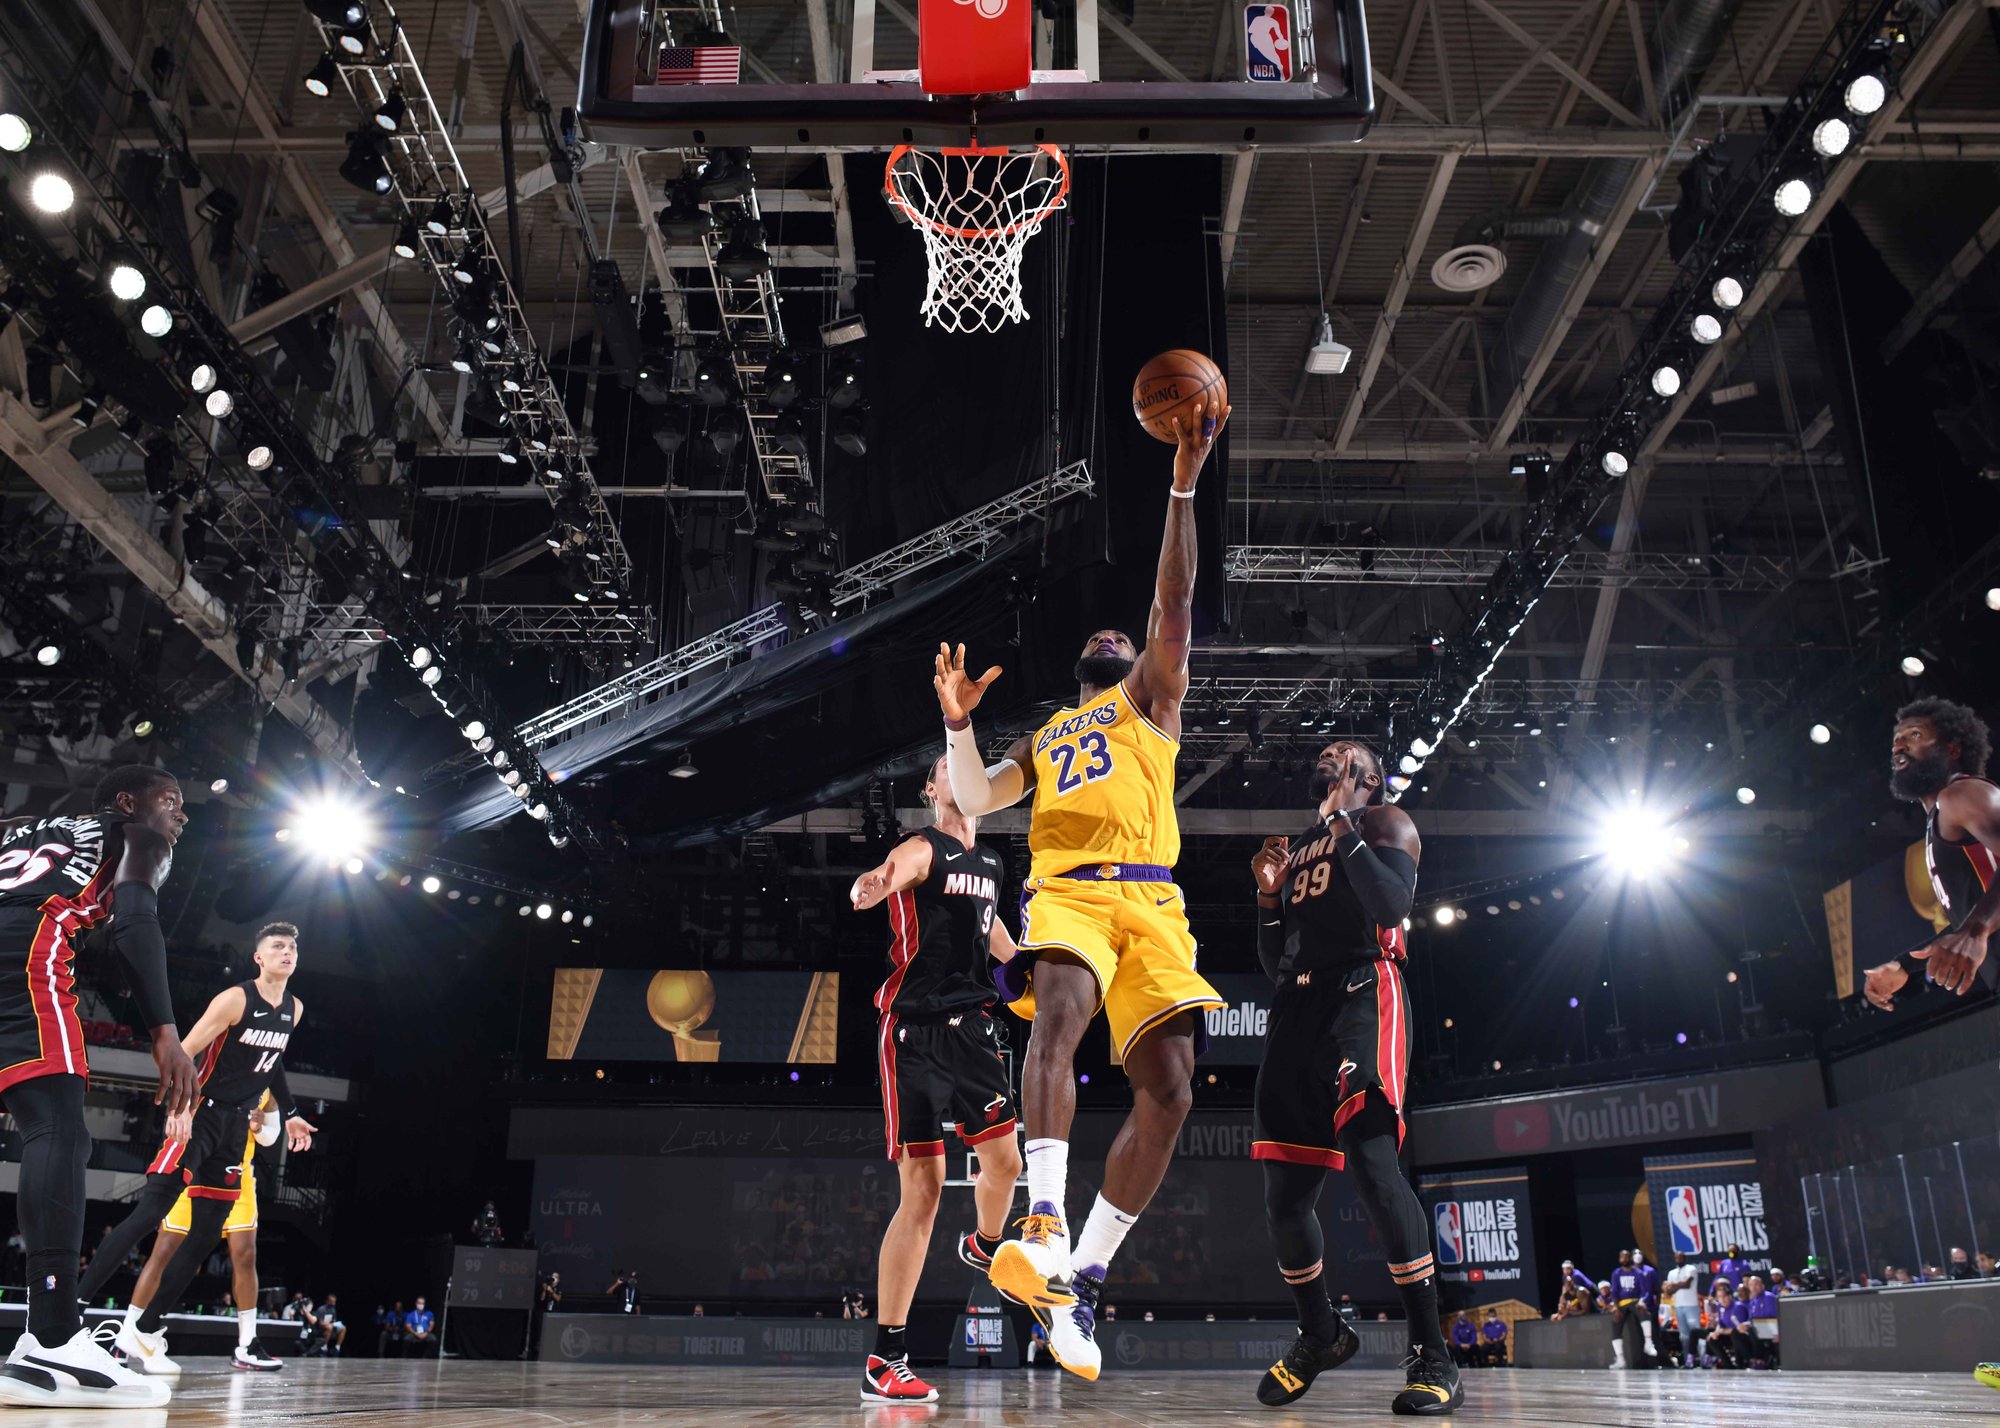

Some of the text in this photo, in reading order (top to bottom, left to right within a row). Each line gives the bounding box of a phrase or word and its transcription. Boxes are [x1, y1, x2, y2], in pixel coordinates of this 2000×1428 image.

[1254, 64, 1275, 78] NBA
[1133, 383, 1180, 415] PALDING
[1035, 701, 1118, 758] LAKERS
[1049, 730, 1115, 797] 23
[943, 873, 995, 901] MIAMI
[1291, 861, 1331, 904] 99
[981, 904, 993, 934] 9
[238, 1027, 290, 1053] MIAMI
[252, 1050, 280, 1073] 14
[660, 1120, 752, 1153] LEAVE
[802, 1124, 888, 1152] LEGAC
[1178, 1125, 1252, 1156] LAYOFF
[540, 1200, 603, 1216] ULTRA
[1495, 1198, 1517, 1230] 2020
[1698, 1183, 1742, 1219] NBA
[1739, 1182, 1765, 1217] 2020
[1462, 1200, 1497, 1232] NBA
[1465, 1229, 1520, 1263] FINALS
[1704, 1216, 1770, 1253] FINALS
[683, 1335, 745, 1356] TOGETHER
[774, 1327, 802, 1352] NBA
[803, 1327, 847, 1352] FINALS
[1359, 1331, 1403, 1355] FINALS
